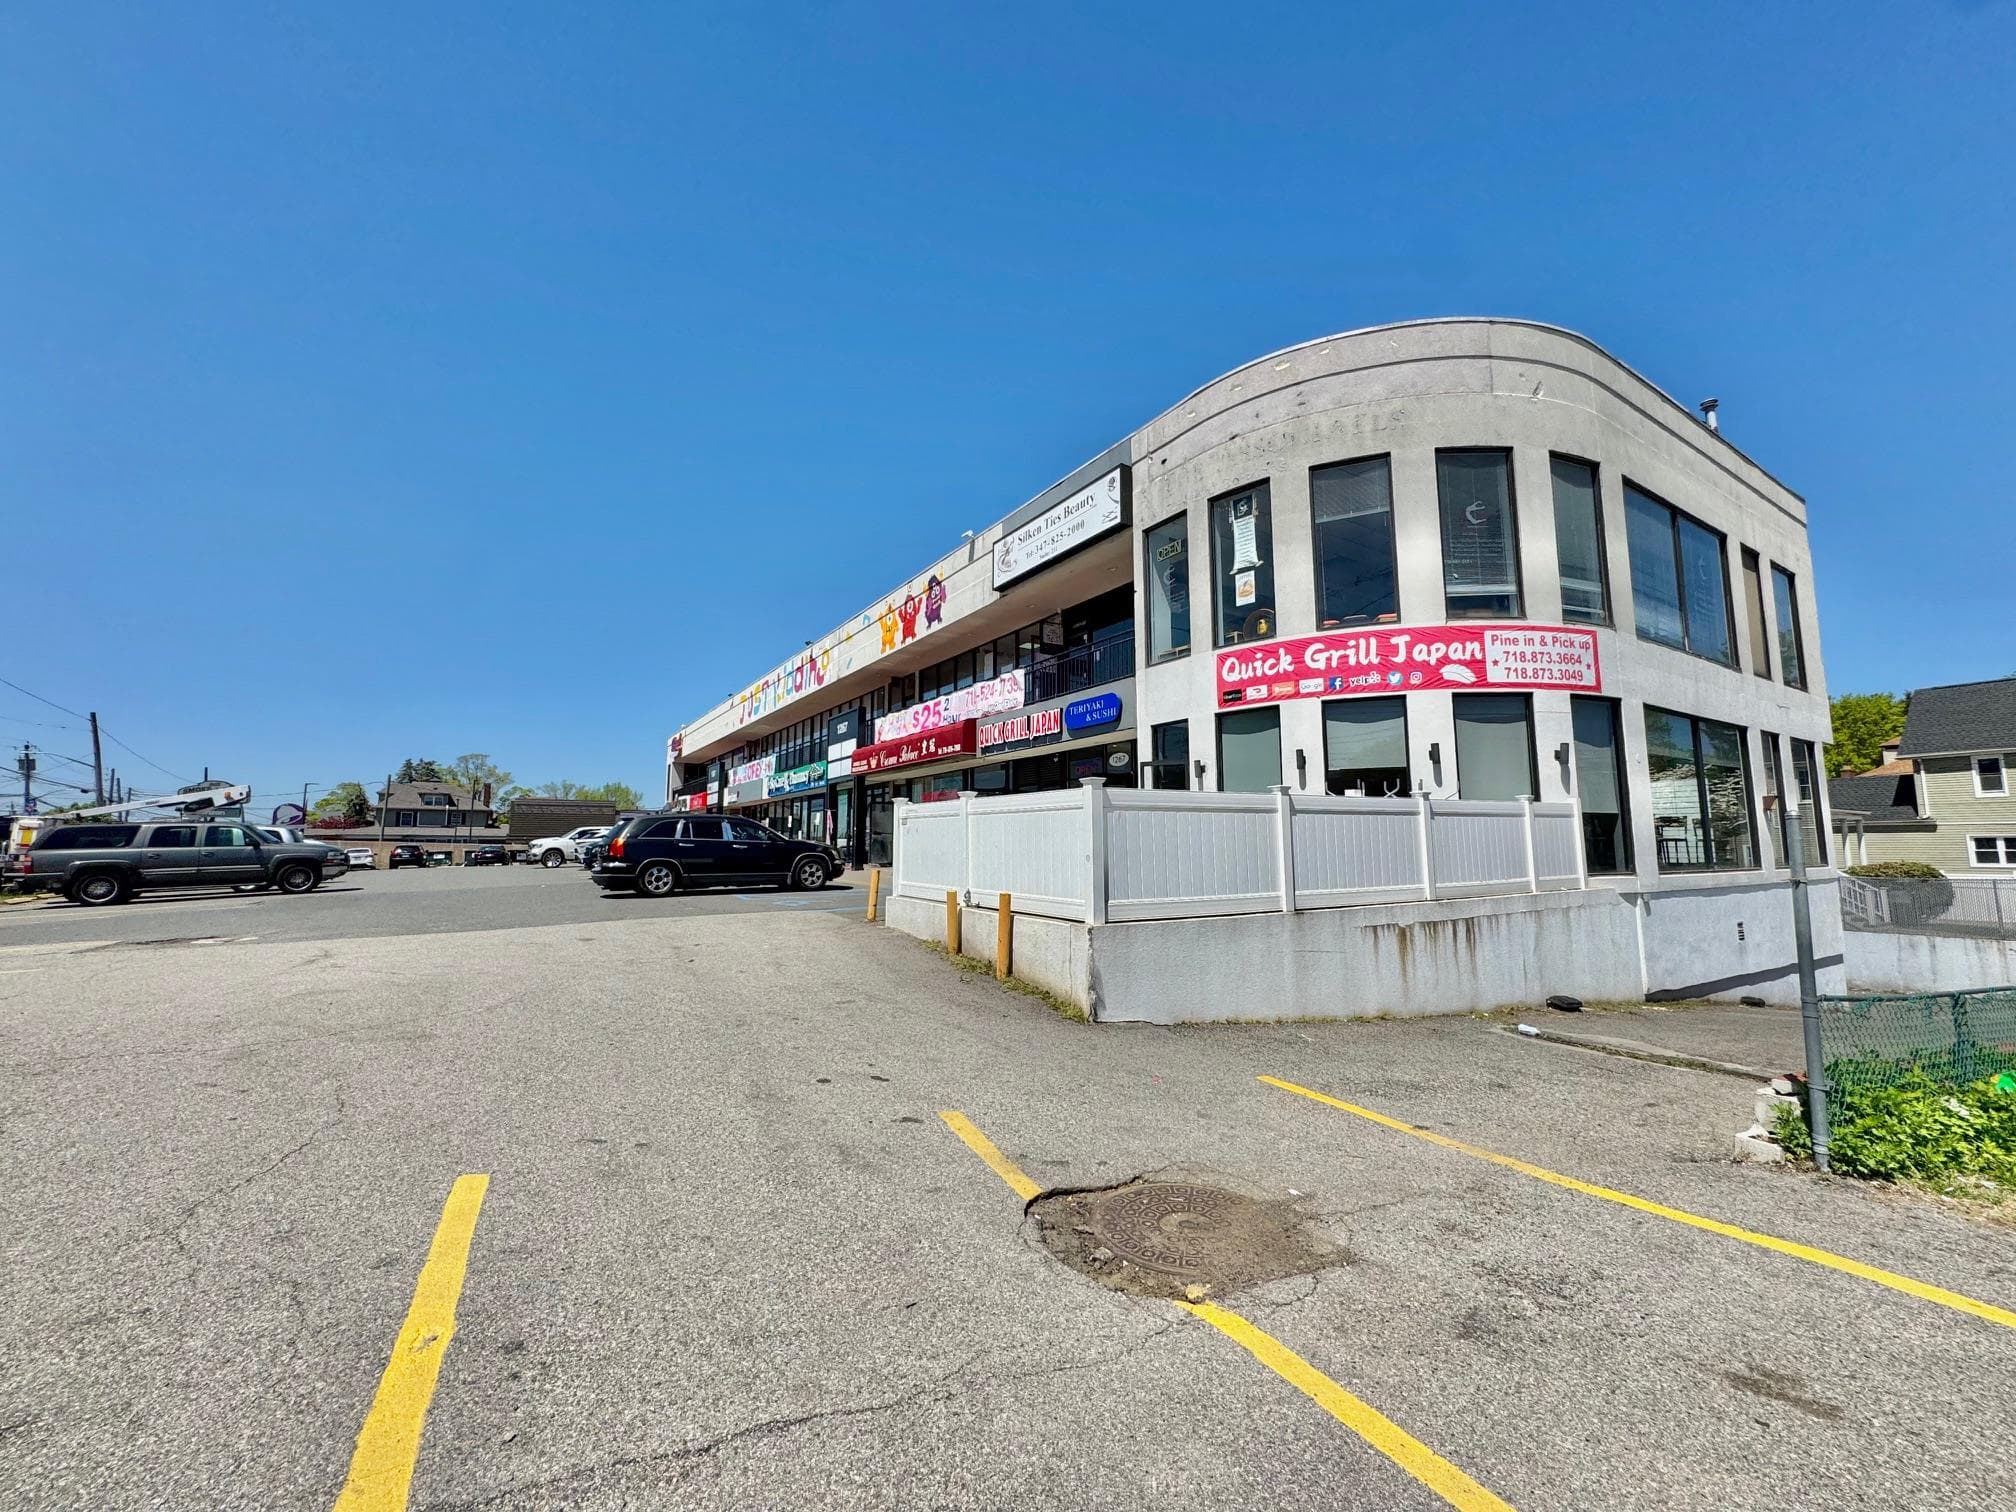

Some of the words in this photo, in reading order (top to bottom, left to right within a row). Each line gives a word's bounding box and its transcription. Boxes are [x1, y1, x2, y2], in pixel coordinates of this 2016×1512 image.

[1018, 525, 1041, 545] Silken
[1044, 513, 1061, 530] Ties
[1063, 492, 1096, 519] Beauty
[1158, 540, 1181, 560] OPEN
[1490, 634, 1520, 647] Pine
[1523, 634, 1535, 647] in
[1539, 635, 1548, 647] &
[1552, 635, 1576, 649] Pick
[1579, 640, 1591, 653] up
[1221, 648, 1295, 683] Quick
[1304, 636, 1381, 670] Grill
[1389, 634, 1483, 665] Japan
[1503, 650, 1583, 666] 718.873.3664
[1504, 666, 1584, 681] 718.873.3049
[1068, 700, 1104, 716] TERIYAKI
[1085, 713, 1091, 721] &
[1091, 707, 1118, 720] SUSHI
[979, 722, 1004, 748] QUICK
[1004, 715, 1029, 742] GRILL
[1030, 708, 1061, 740] JAPAN
